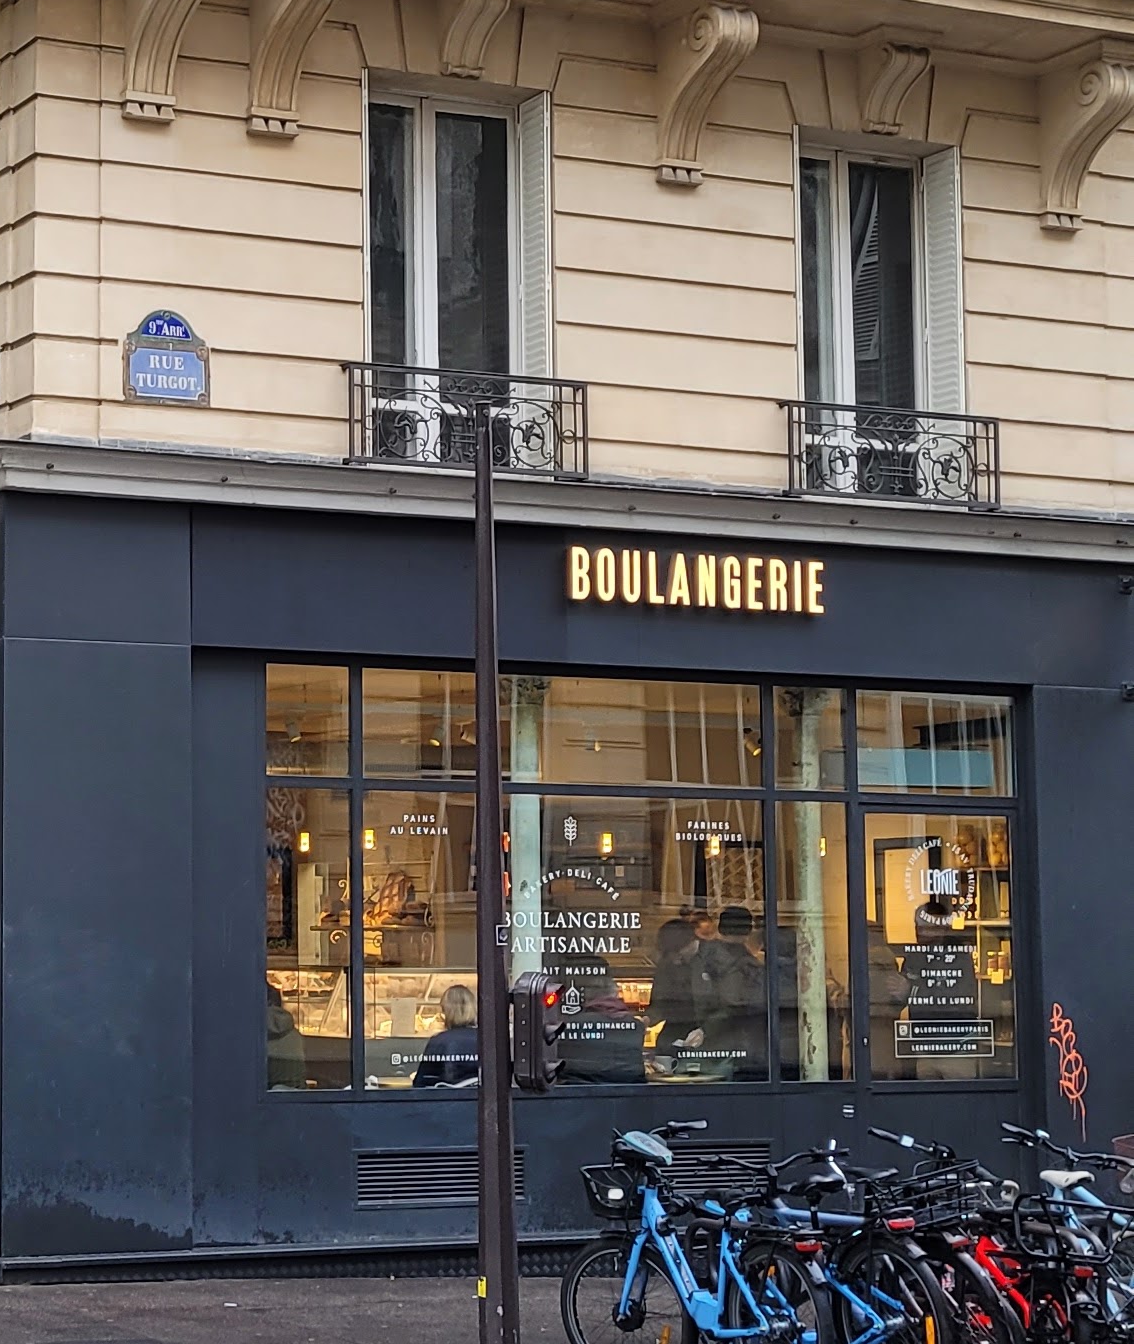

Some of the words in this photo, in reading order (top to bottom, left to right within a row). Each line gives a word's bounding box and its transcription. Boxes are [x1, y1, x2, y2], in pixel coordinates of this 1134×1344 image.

[149, 355, 184, 370] RUE
[570, 546, 825, 614] BOULANGERIE
[403, 814, 436, 823] PAINS
[687, 821, 730, 830] FARINES
[390, 826, 404, 835] AU
[410, 826, 448, 835] LEVAIN
[510, 936, 631, 954] ARTISANALE
[905, 945, 930, 953] MARDI
[933, 945, 944, 953] AU
[948, 945, 977, 953] SAMEDI
[542, 967, 560, 975] AIT
[566, 967, 606, 975] MAISON
[921, 969, 963, 977] DIMANCHE
[908, 996, 934, 1004] FERMÉ
[566, 1022, 580, 1030] RDI
[583, 1022, 594, 1030] AU
[596, 1022, 636, 1030] DIMANCHE
[568, 1032, 578, 1040] LE
[581, 1032, 605, 1040] LUNDI
